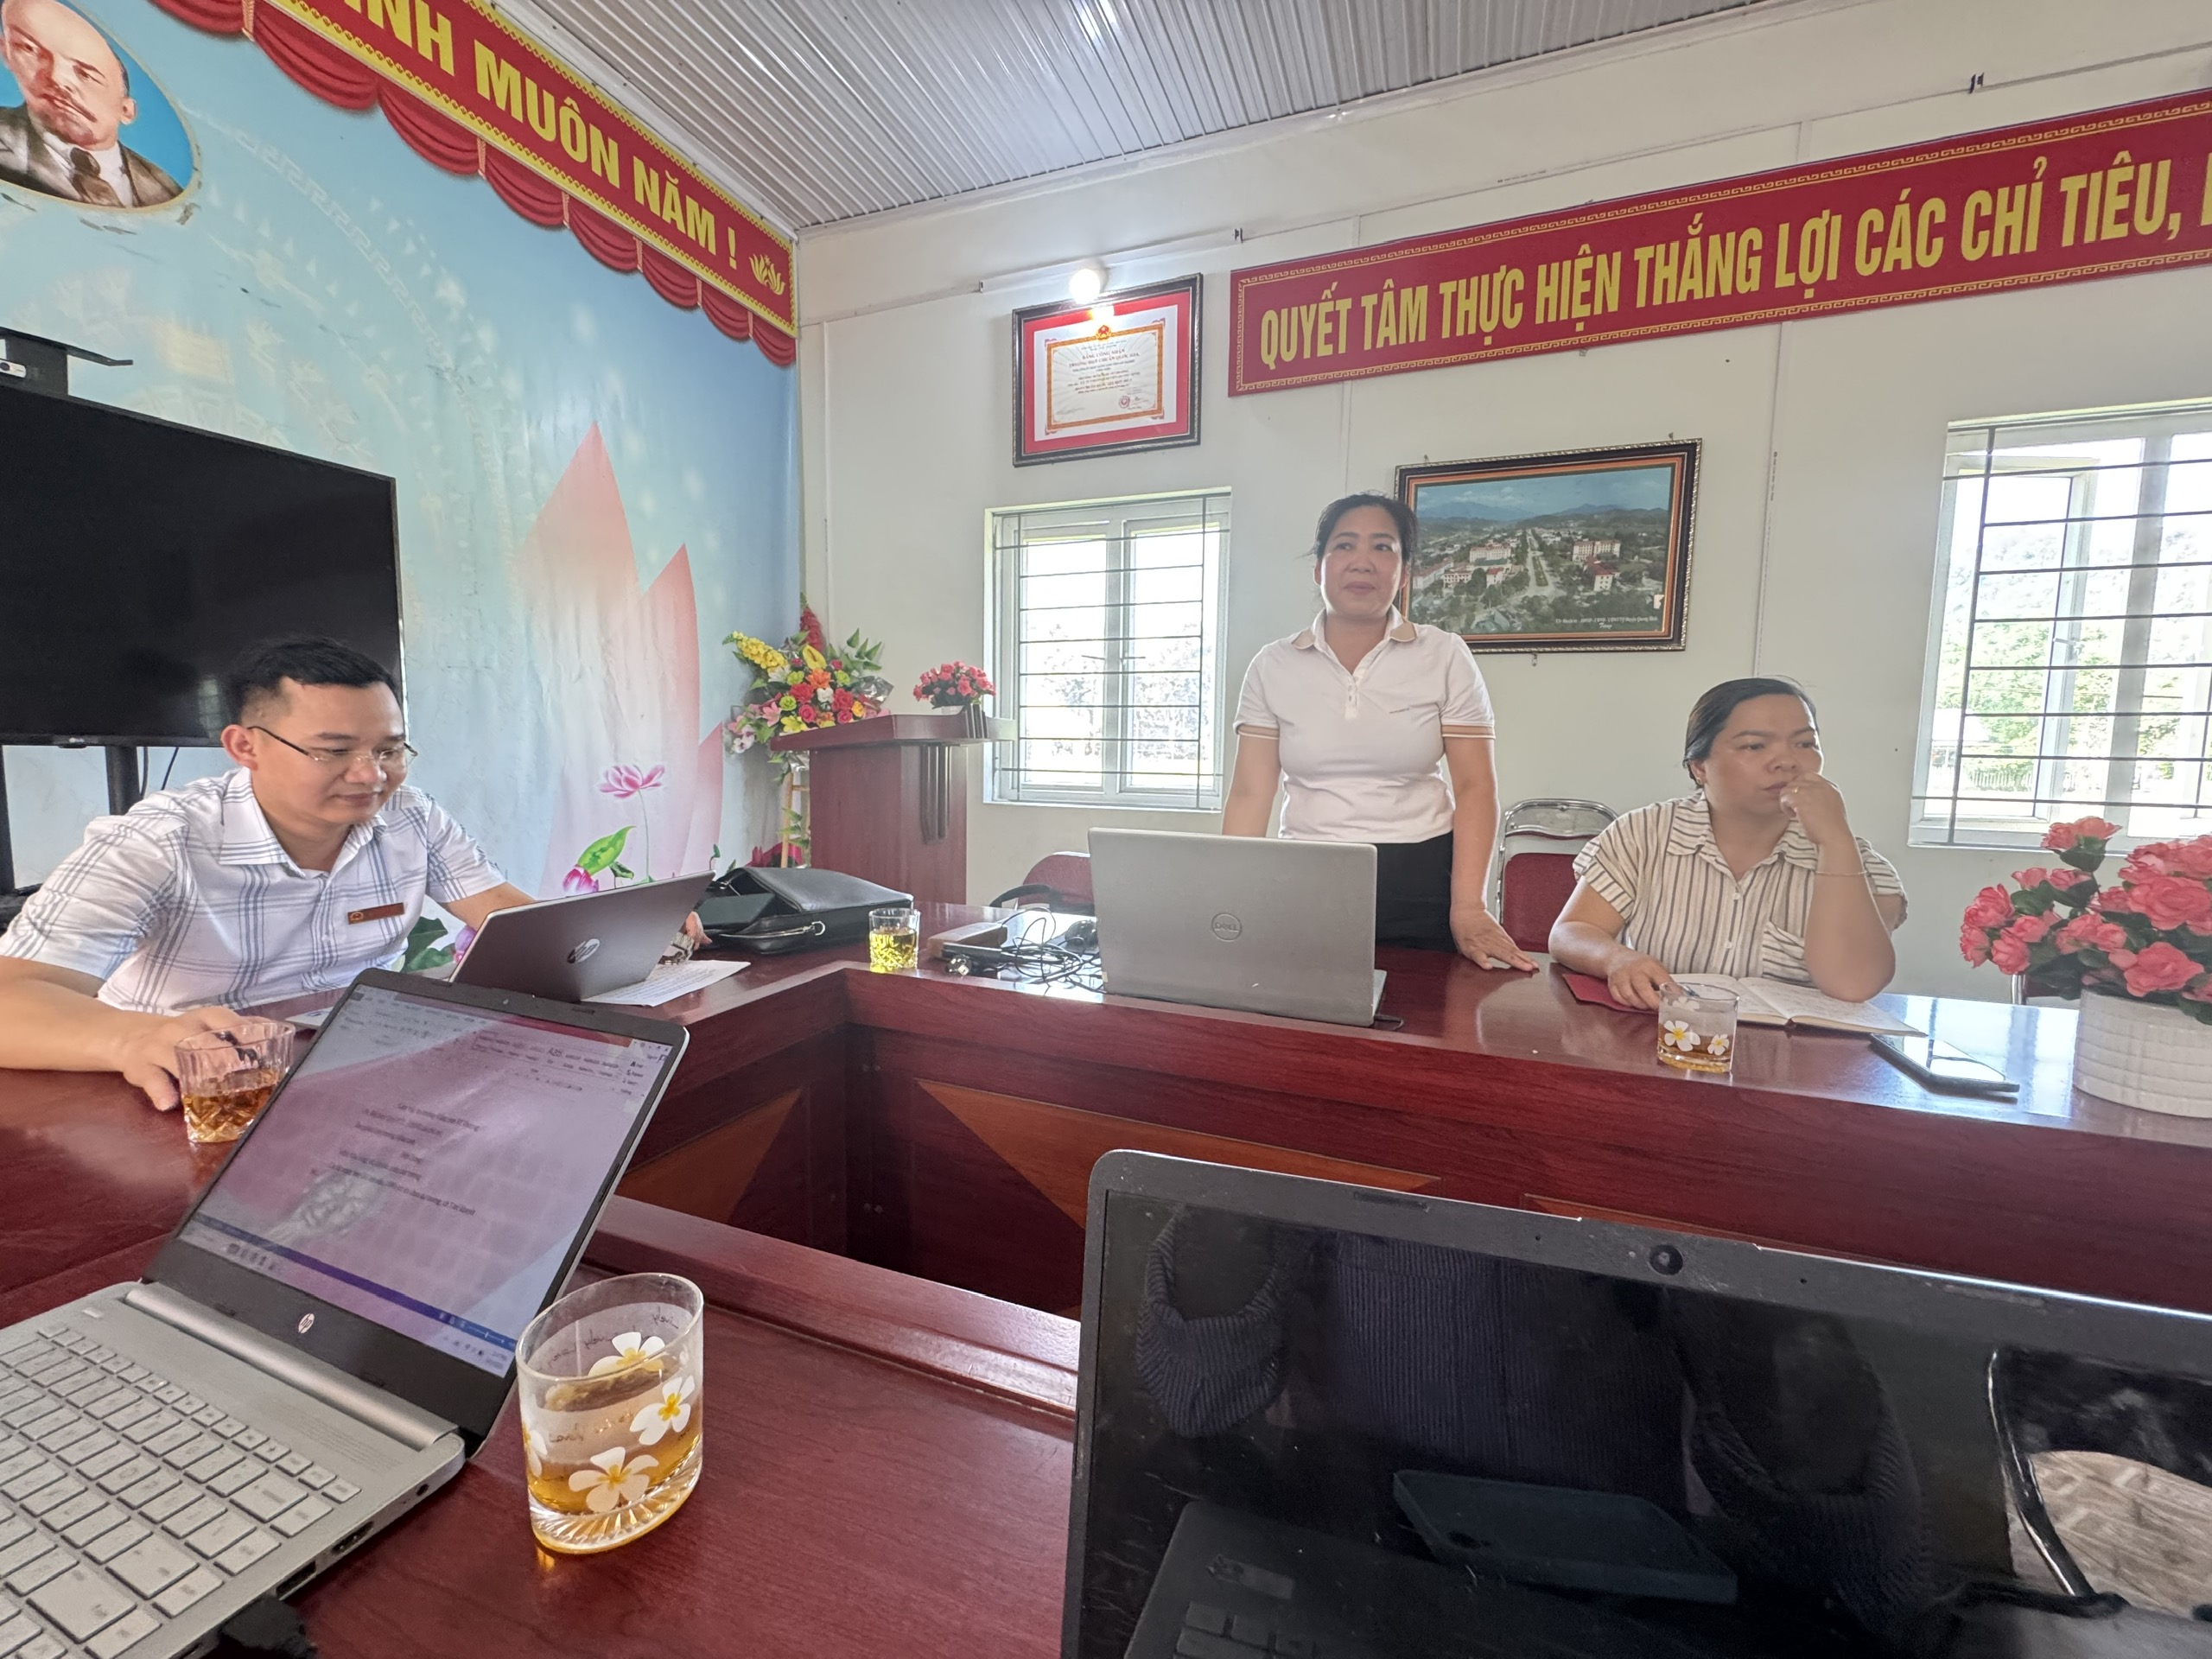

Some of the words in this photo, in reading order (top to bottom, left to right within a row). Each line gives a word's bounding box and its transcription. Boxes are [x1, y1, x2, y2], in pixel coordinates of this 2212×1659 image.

[474, 39, 620, 189] MUÔN
[633, 156, 716, 256] NĂM
[728, 226, 737, 270] !
[1260, 282, 1352, 371] QUYẾT
[1361, 278, 1428, 350] TÂM
[1439, 264, 1524, 346] THỰC
[1535, 244, 1622, 333] HIỆN
[1634, 212, 1763, 308] THẮNG
[1774, 209, 1842, 299] LỢI
[1854, 188, 1947, 276] CÁC
[1961, 156, 2044, 262] CHỈ
[2060, 149, 2183, 247] TIÊU,
[298, 1313, 315, 1334] hp
